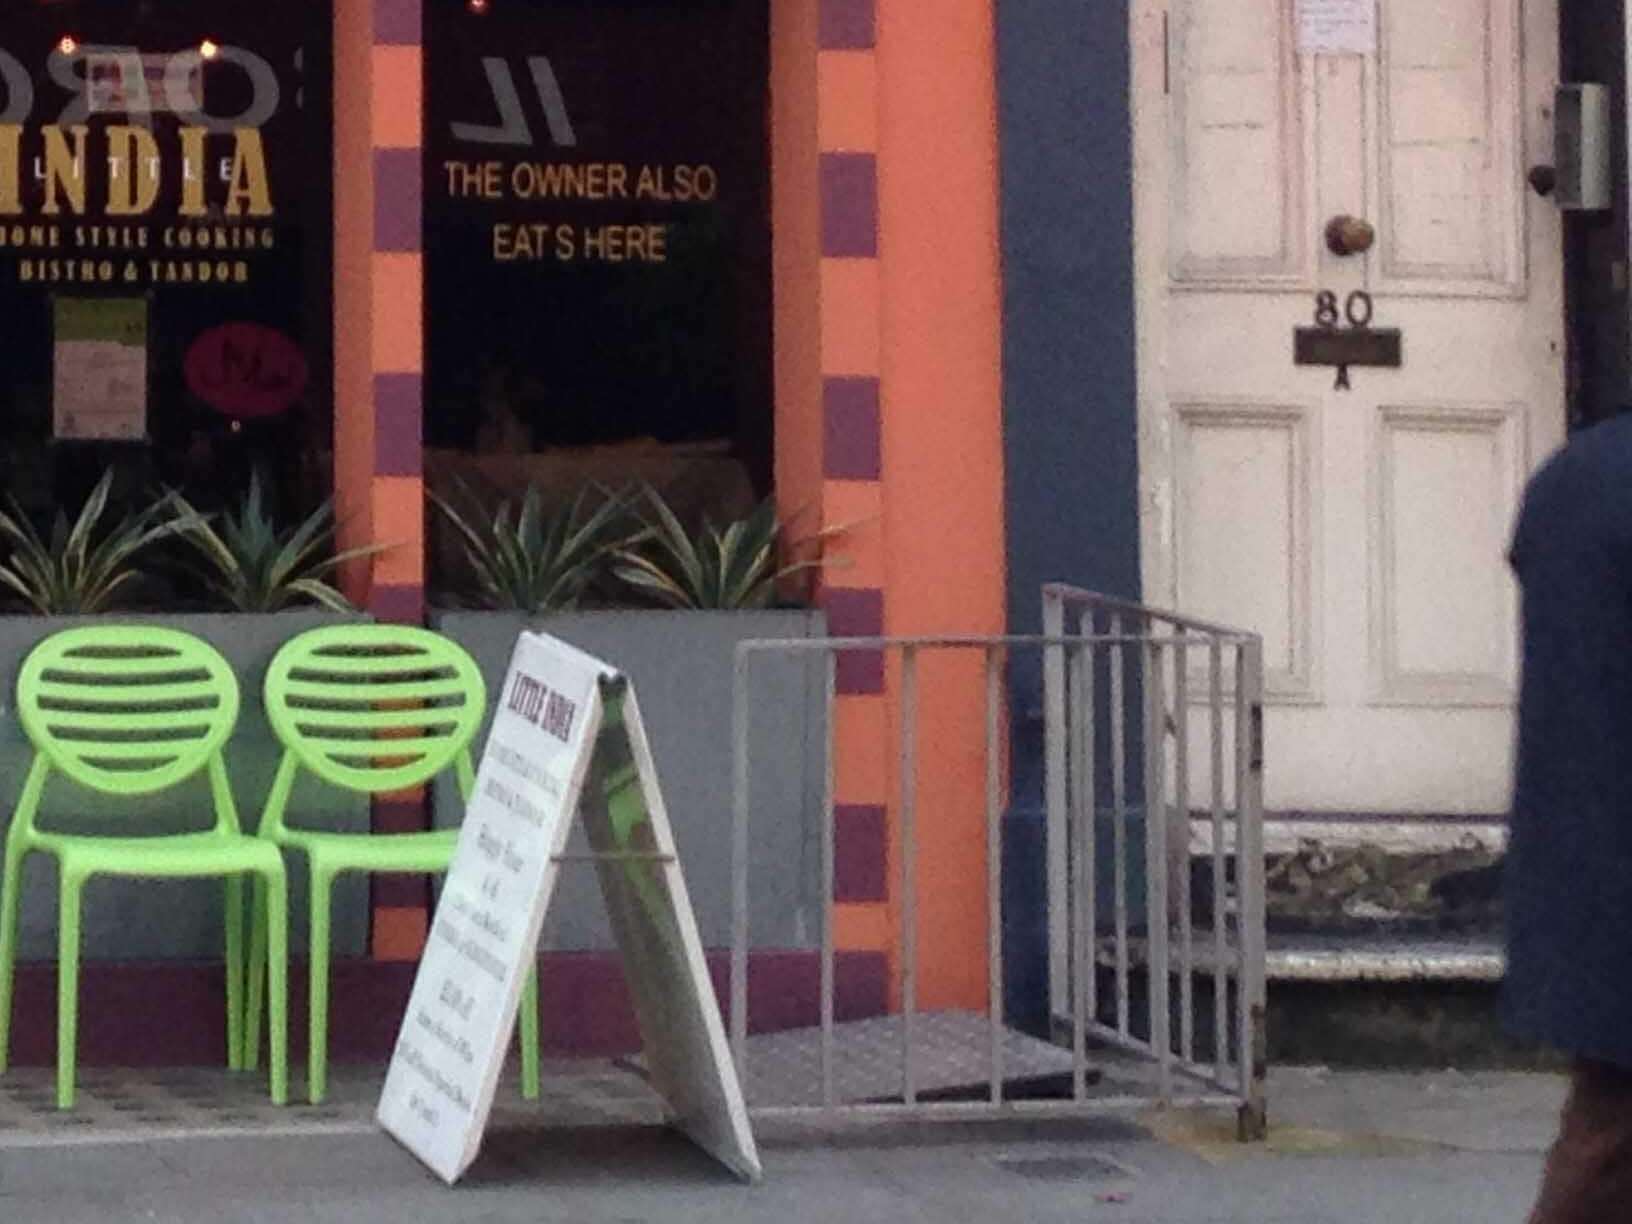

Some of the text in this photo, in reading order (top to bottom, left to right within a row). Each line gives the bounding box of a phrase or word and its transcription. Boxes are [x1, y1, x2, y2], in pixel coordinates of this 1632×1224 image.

[33, 156, 234, 181] LITTLE
[444, 161, 717, 201] THE OWNER ALSO
[75, 225, 148, 248] STYLE
[164, 226, 275, 249] COOKING
[584, 226, 666, 263] HERE
[20, 260, 249, 283] BISTRO & TANDOR
[1314, 290, 1374, 327] 80
[1333, 363, 1351, 391] A
